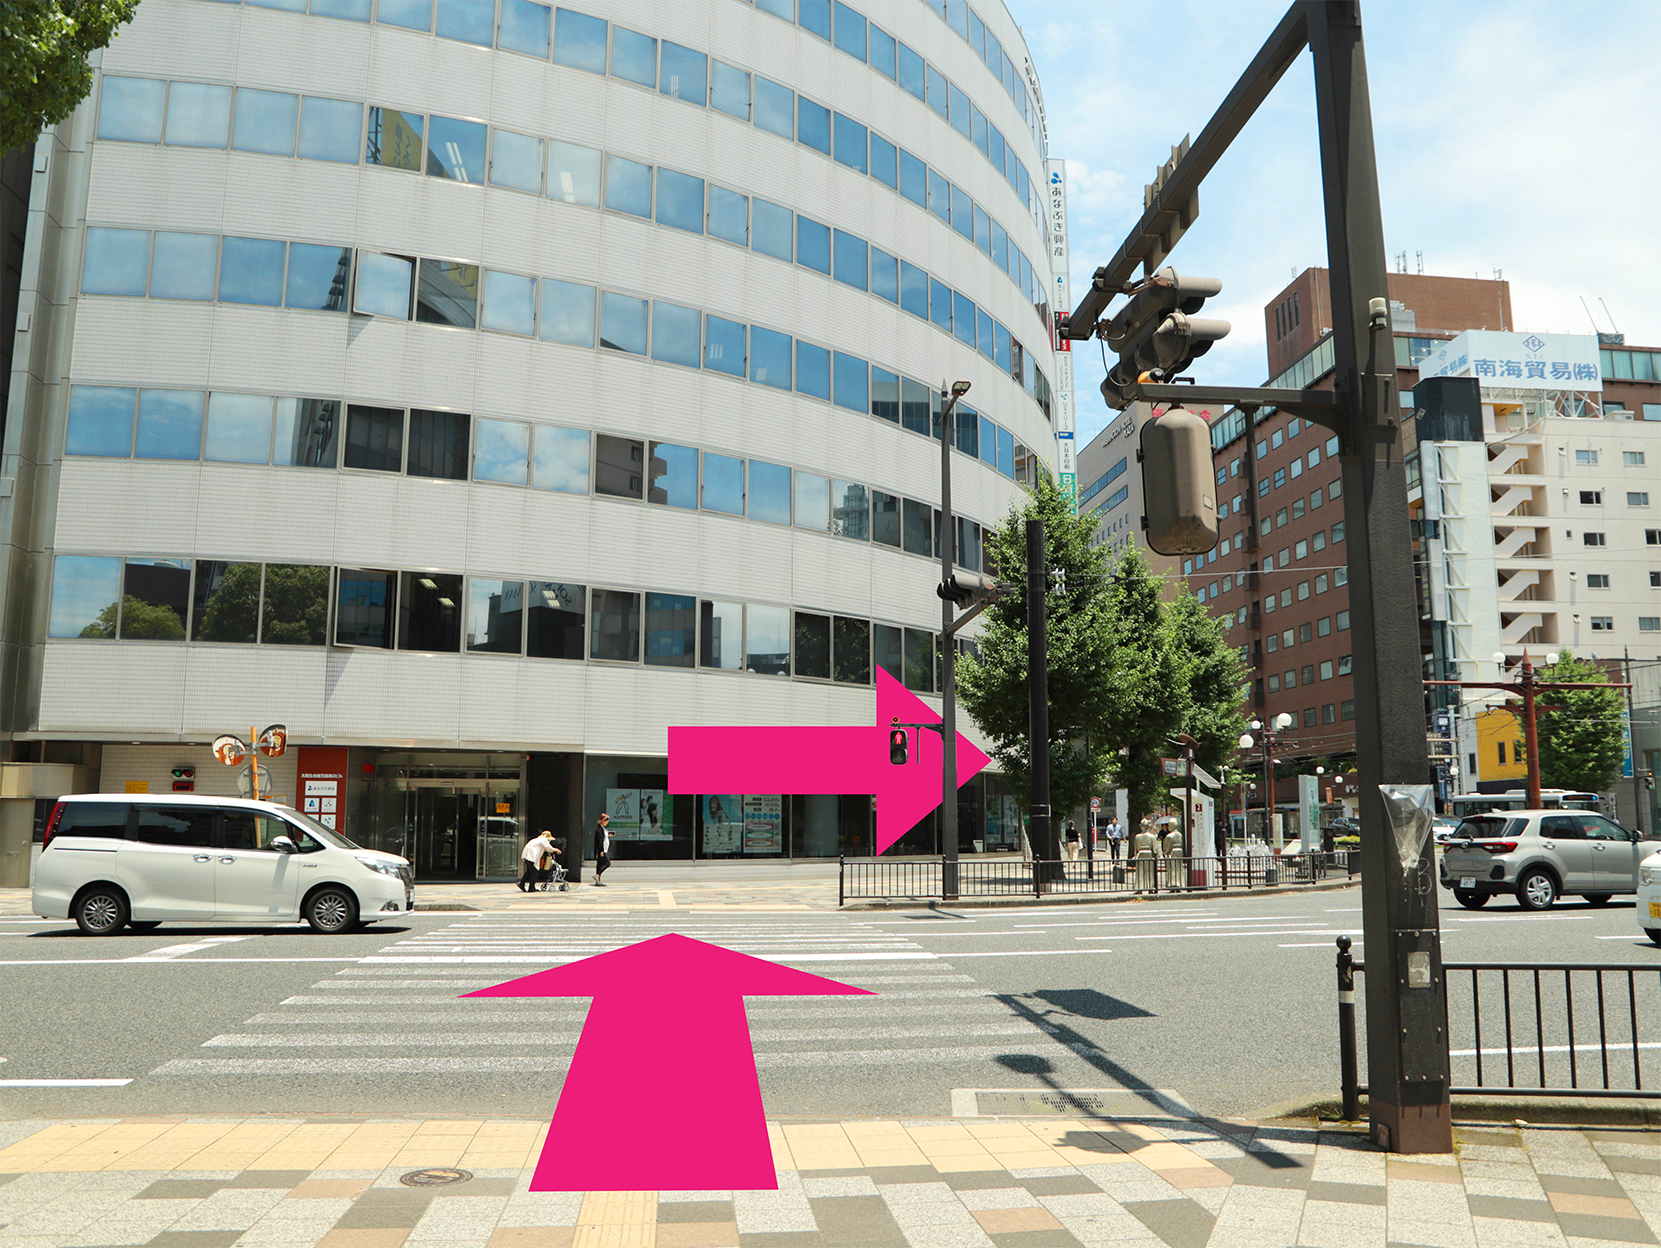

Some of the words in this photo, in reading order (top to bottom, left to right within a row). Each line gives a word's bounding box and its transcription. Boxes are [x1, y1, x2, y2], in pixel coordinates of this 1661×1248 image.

[1052, 187, 1064, 257] あなぶき興産
[1473, 358, 1598, 381] 南海貿易(株)
